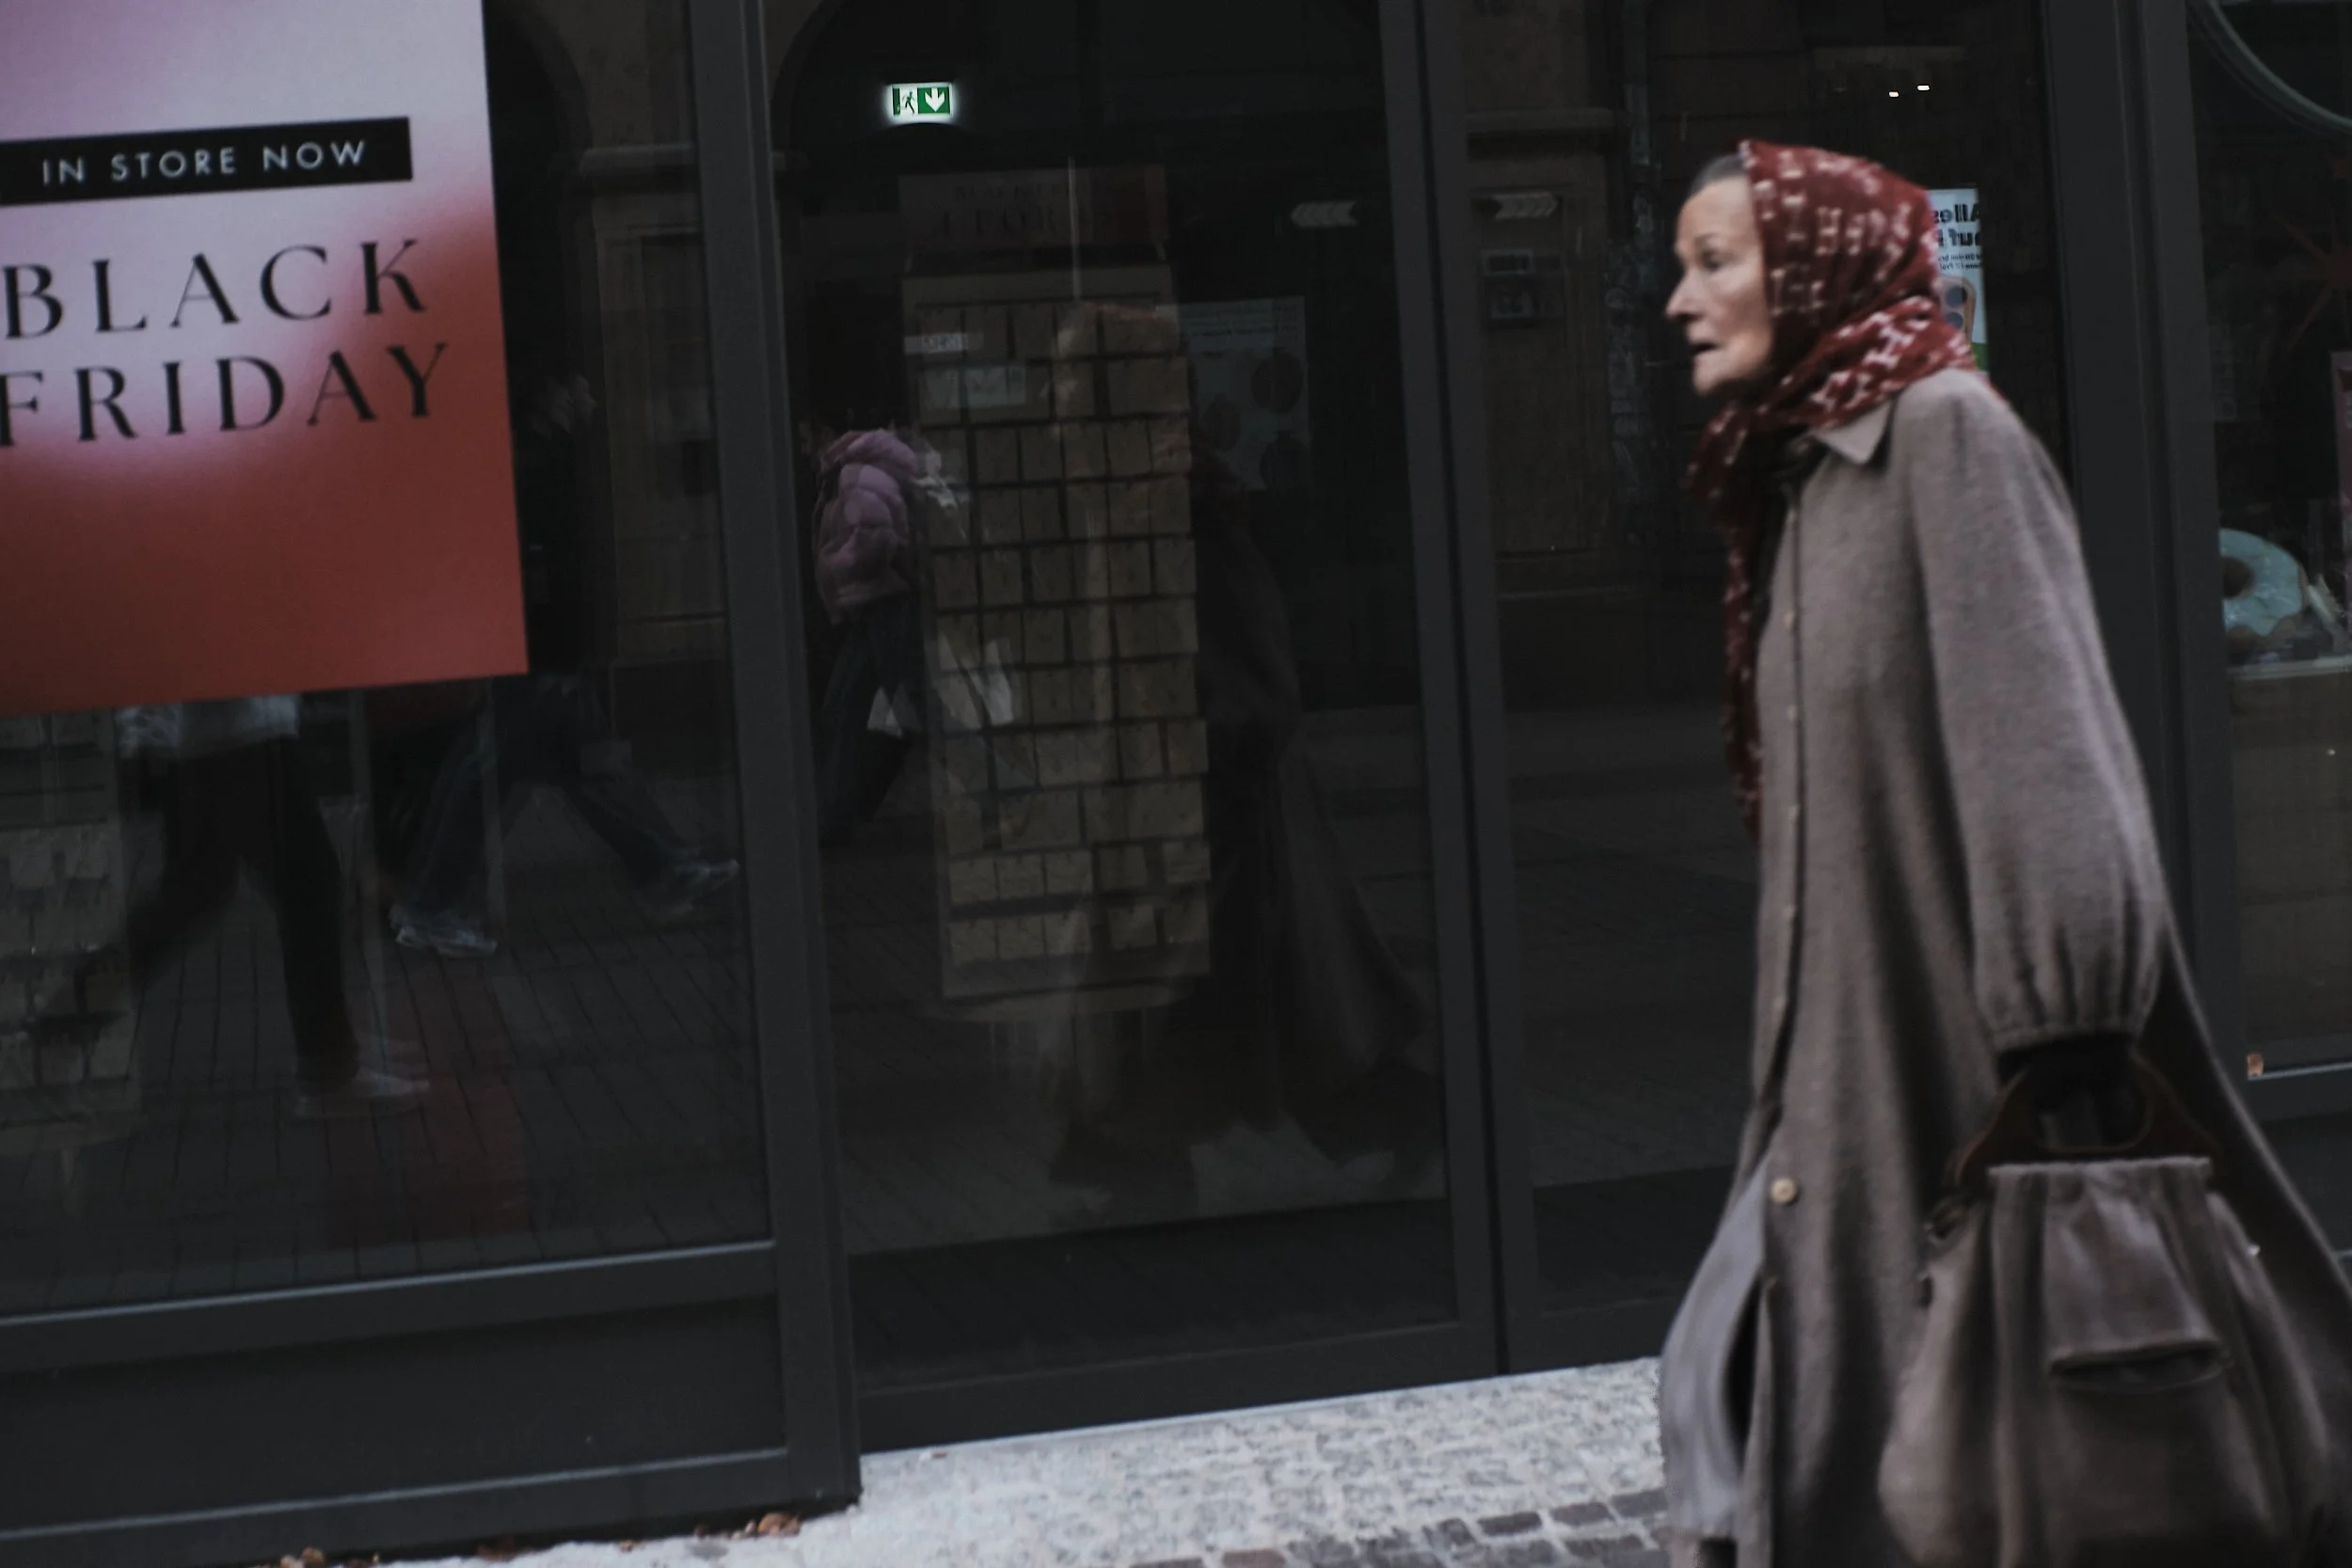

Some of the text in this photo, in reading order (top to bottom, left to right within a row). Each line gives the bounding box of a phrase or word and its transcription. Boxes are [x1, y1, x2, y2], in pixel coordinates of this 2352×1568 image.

[42, 139, 366, 184] IN STORE NOW
[2, 238, 426, 340] BLACK
[0, 342, 448, 447] FRIDAY
